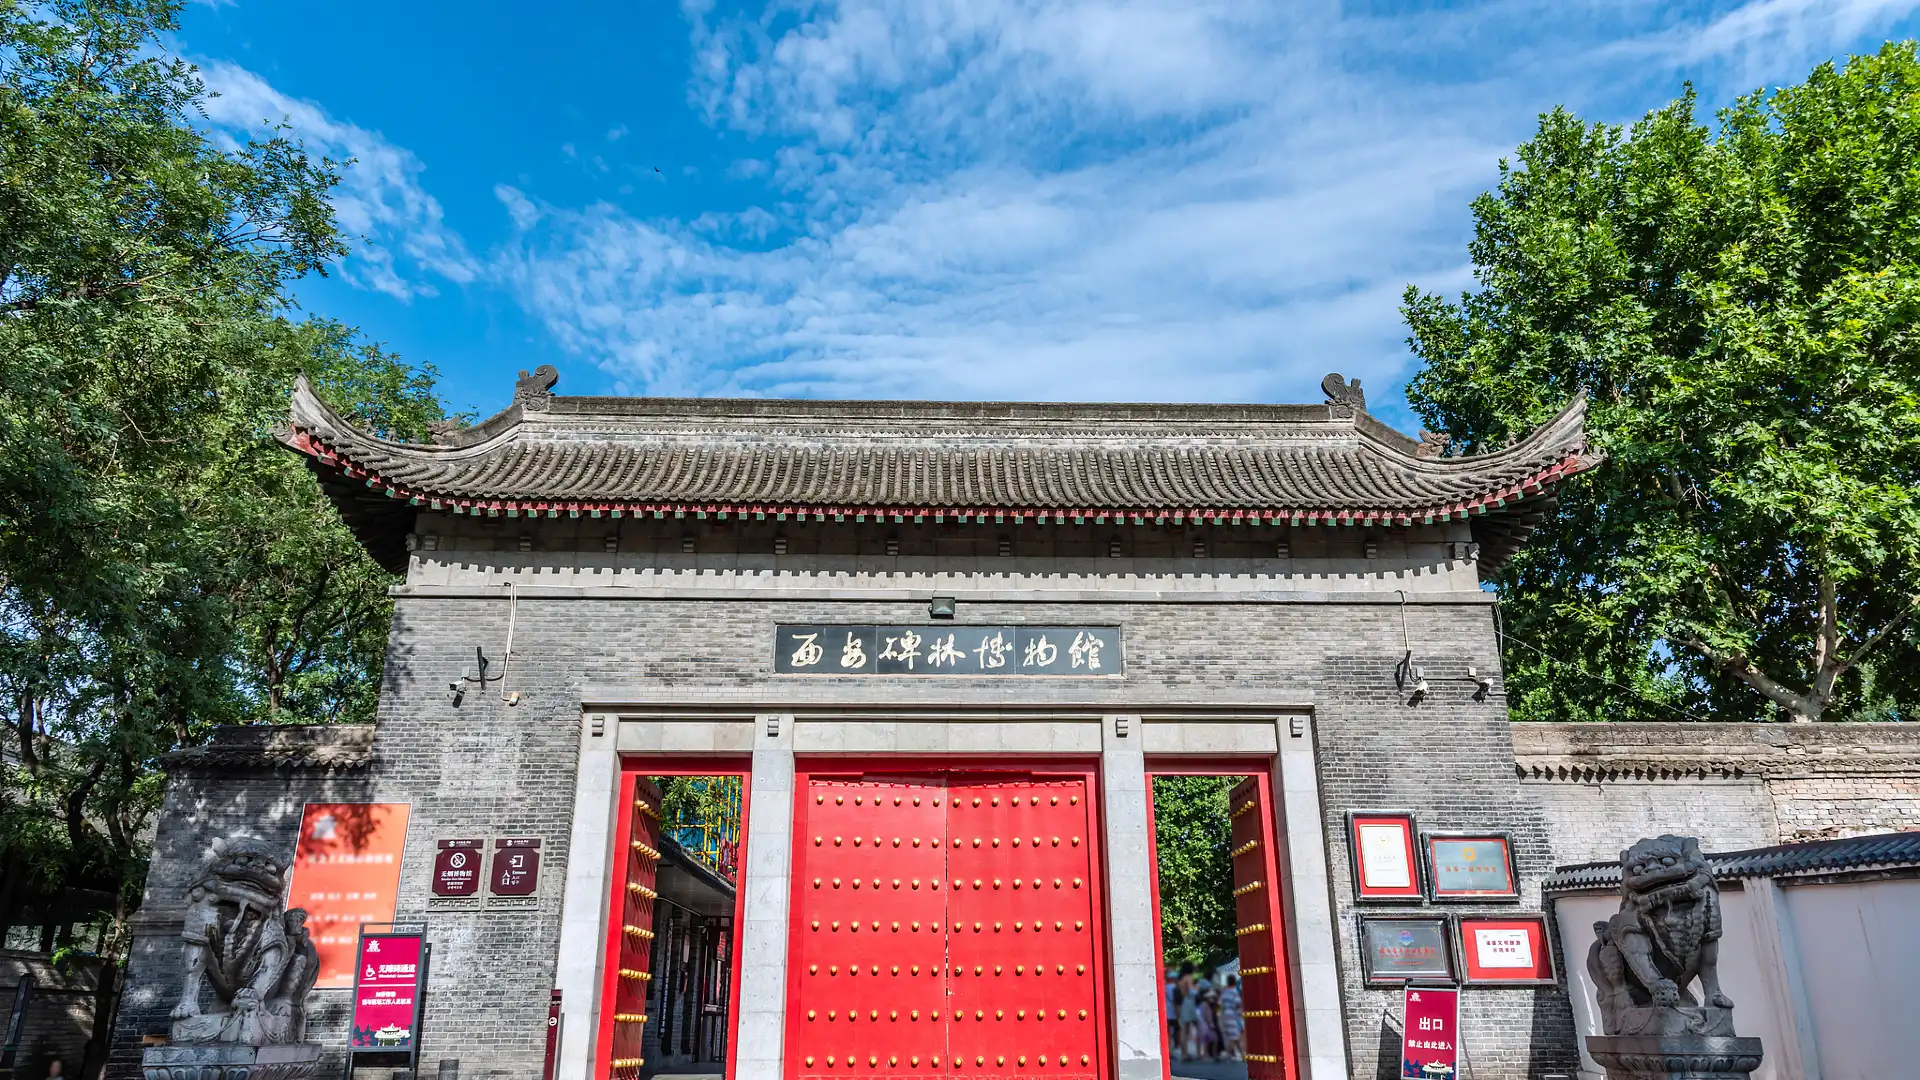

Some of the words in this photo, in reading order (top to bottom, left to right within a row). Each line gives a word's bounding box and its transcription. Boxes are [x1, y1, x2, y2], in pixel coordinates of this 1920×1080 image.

[1419, 1016, 1443, 1031] 出口
[1408, 1039, 1453, 1051] 禁止由此进入
